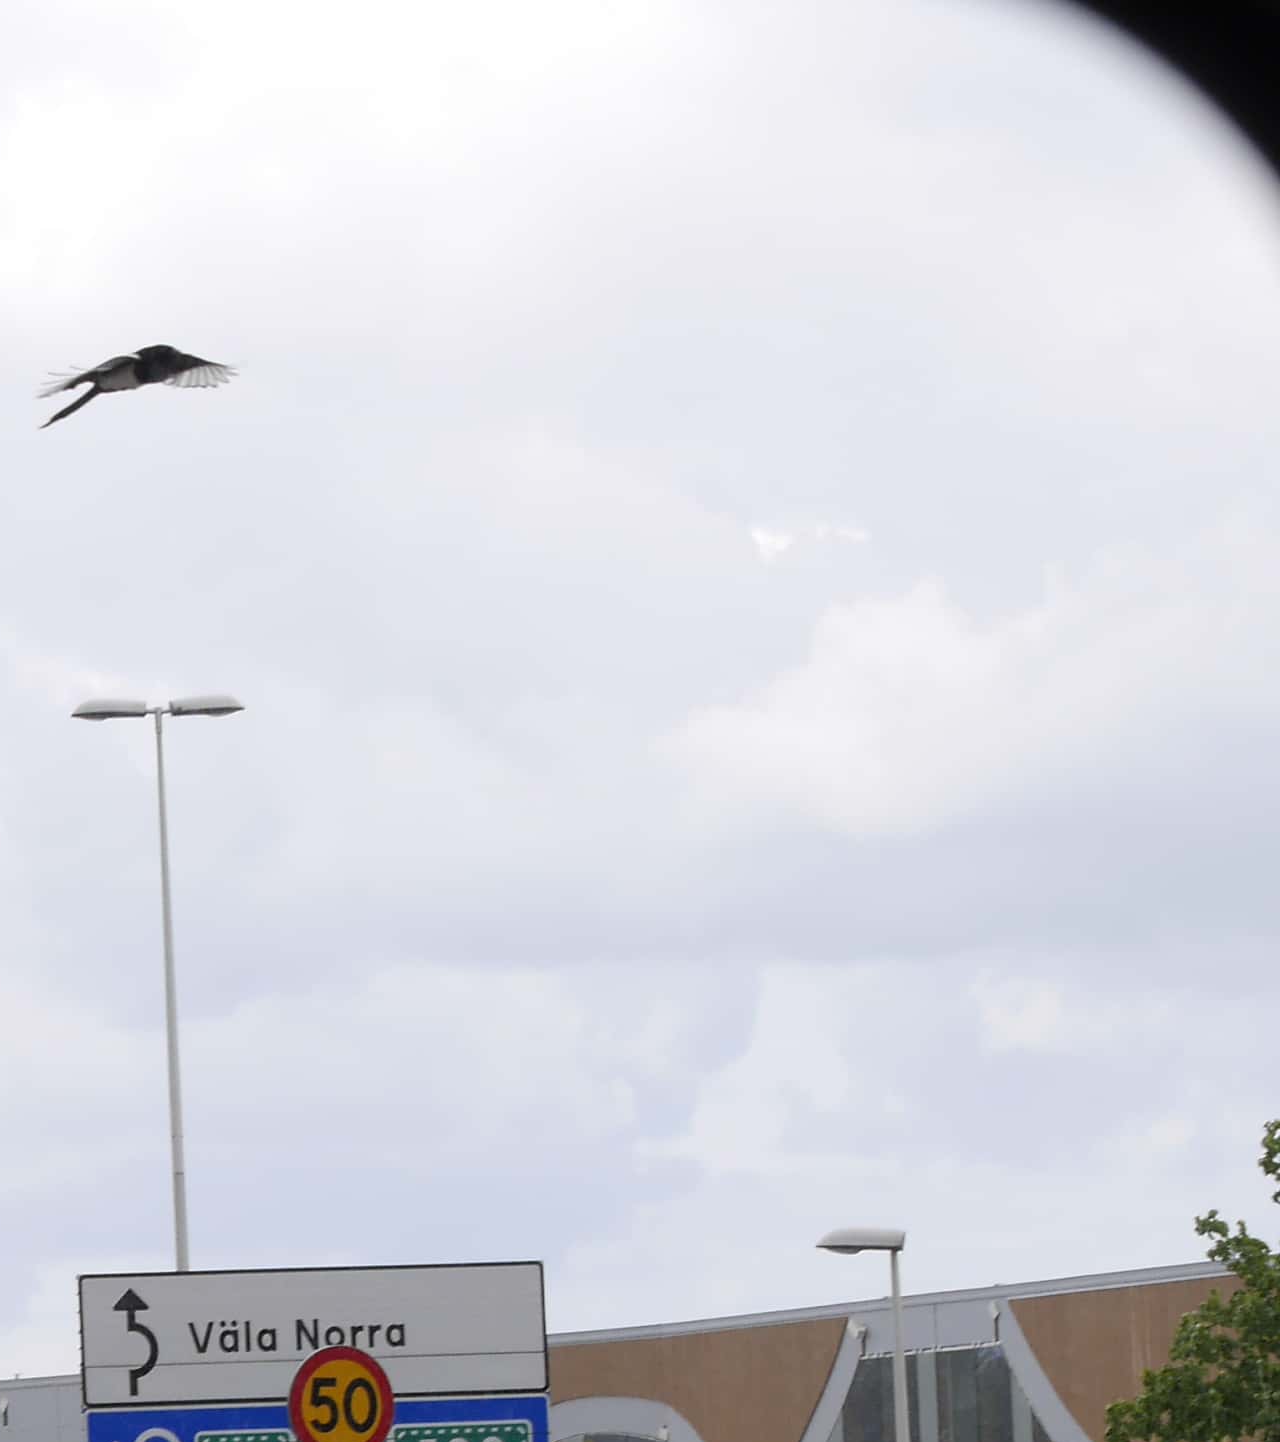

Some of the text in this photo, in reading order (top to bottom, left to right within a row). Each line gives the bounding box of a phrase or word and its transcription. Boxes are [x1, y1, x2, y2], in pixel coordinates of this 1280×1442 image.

[188, 1318, 406, 1354] Väla Norra
[309, 1376, 379, 1434] 50
